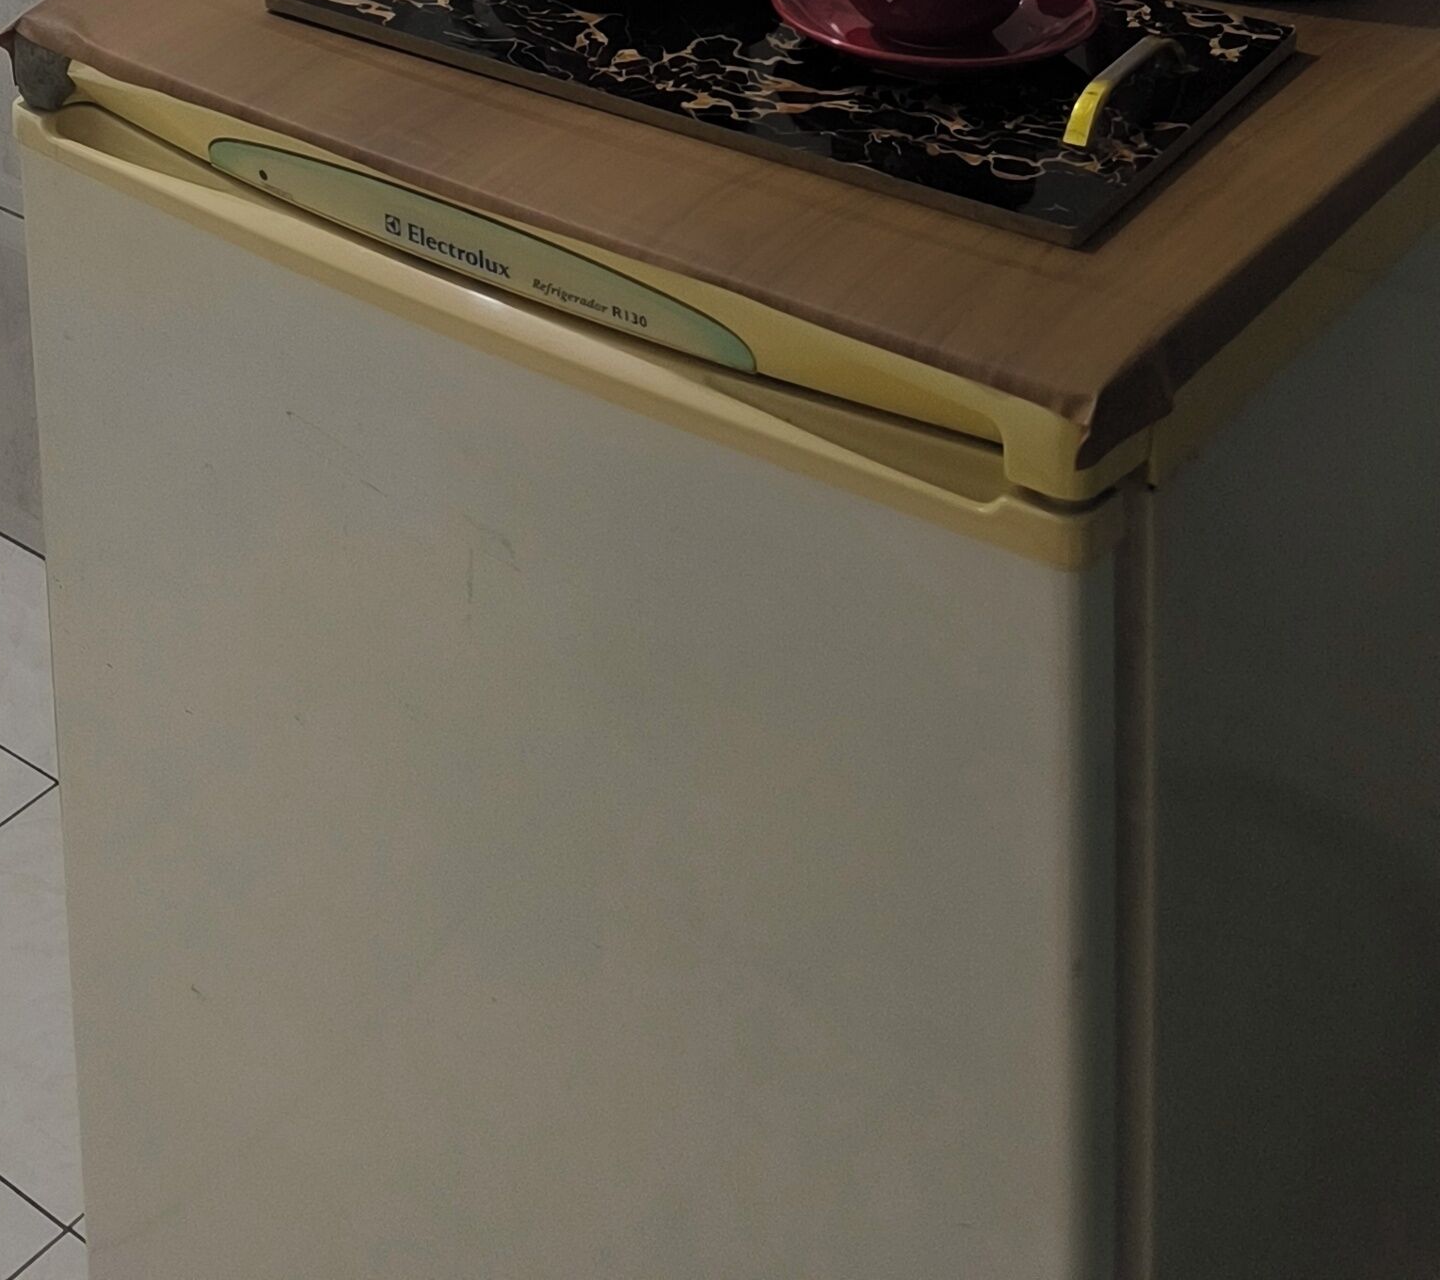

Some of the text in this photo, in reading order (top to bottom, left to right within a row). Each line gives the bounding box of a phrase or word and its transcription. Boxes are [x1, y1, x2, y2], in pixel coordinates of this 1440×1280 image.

[407, 222, 648, 328] Electrolux Refrigerador R130
